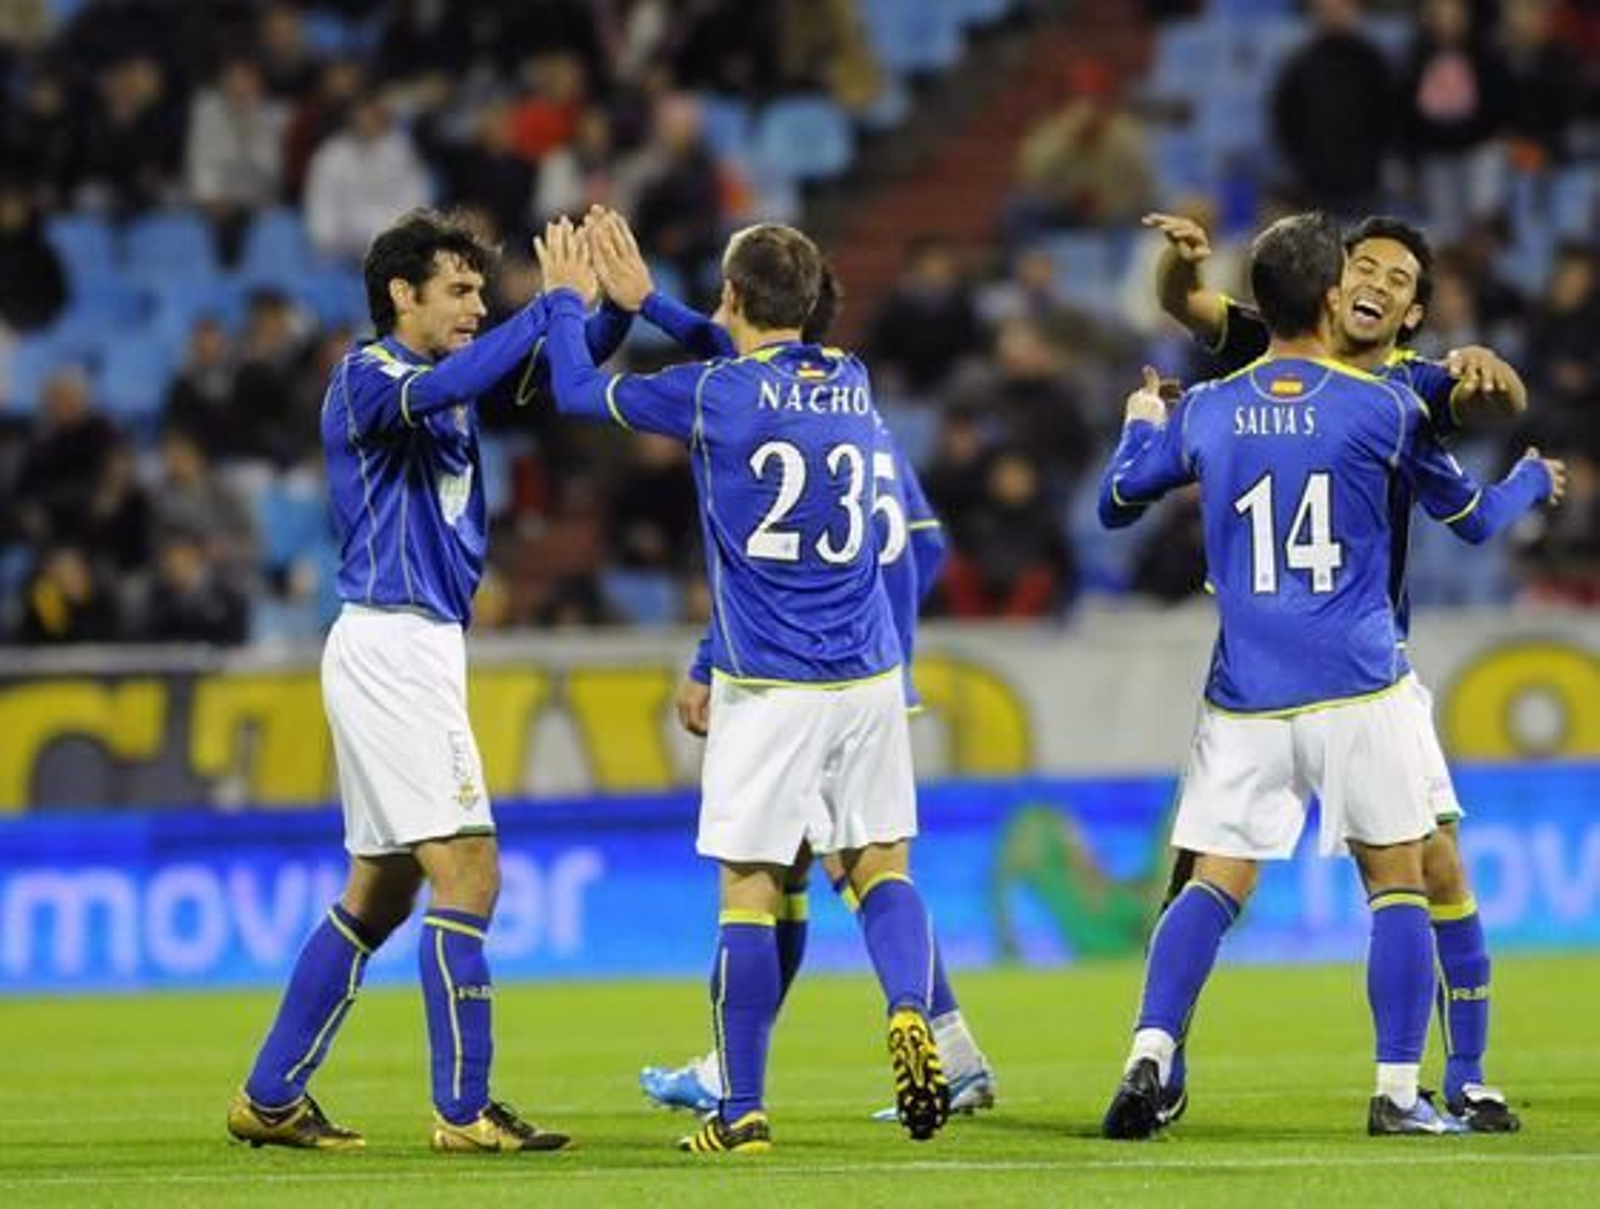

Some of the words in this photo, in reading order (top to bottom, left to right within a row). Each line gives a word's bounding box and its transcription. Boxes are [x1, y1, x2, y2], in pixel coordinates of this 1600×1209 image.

[757, 380, 870, 416] NACHO
[1234, 407, 1298, 436] SALVA
[746, 440, 865, 564] 23
[1234, 472, 1343, 593] 14
